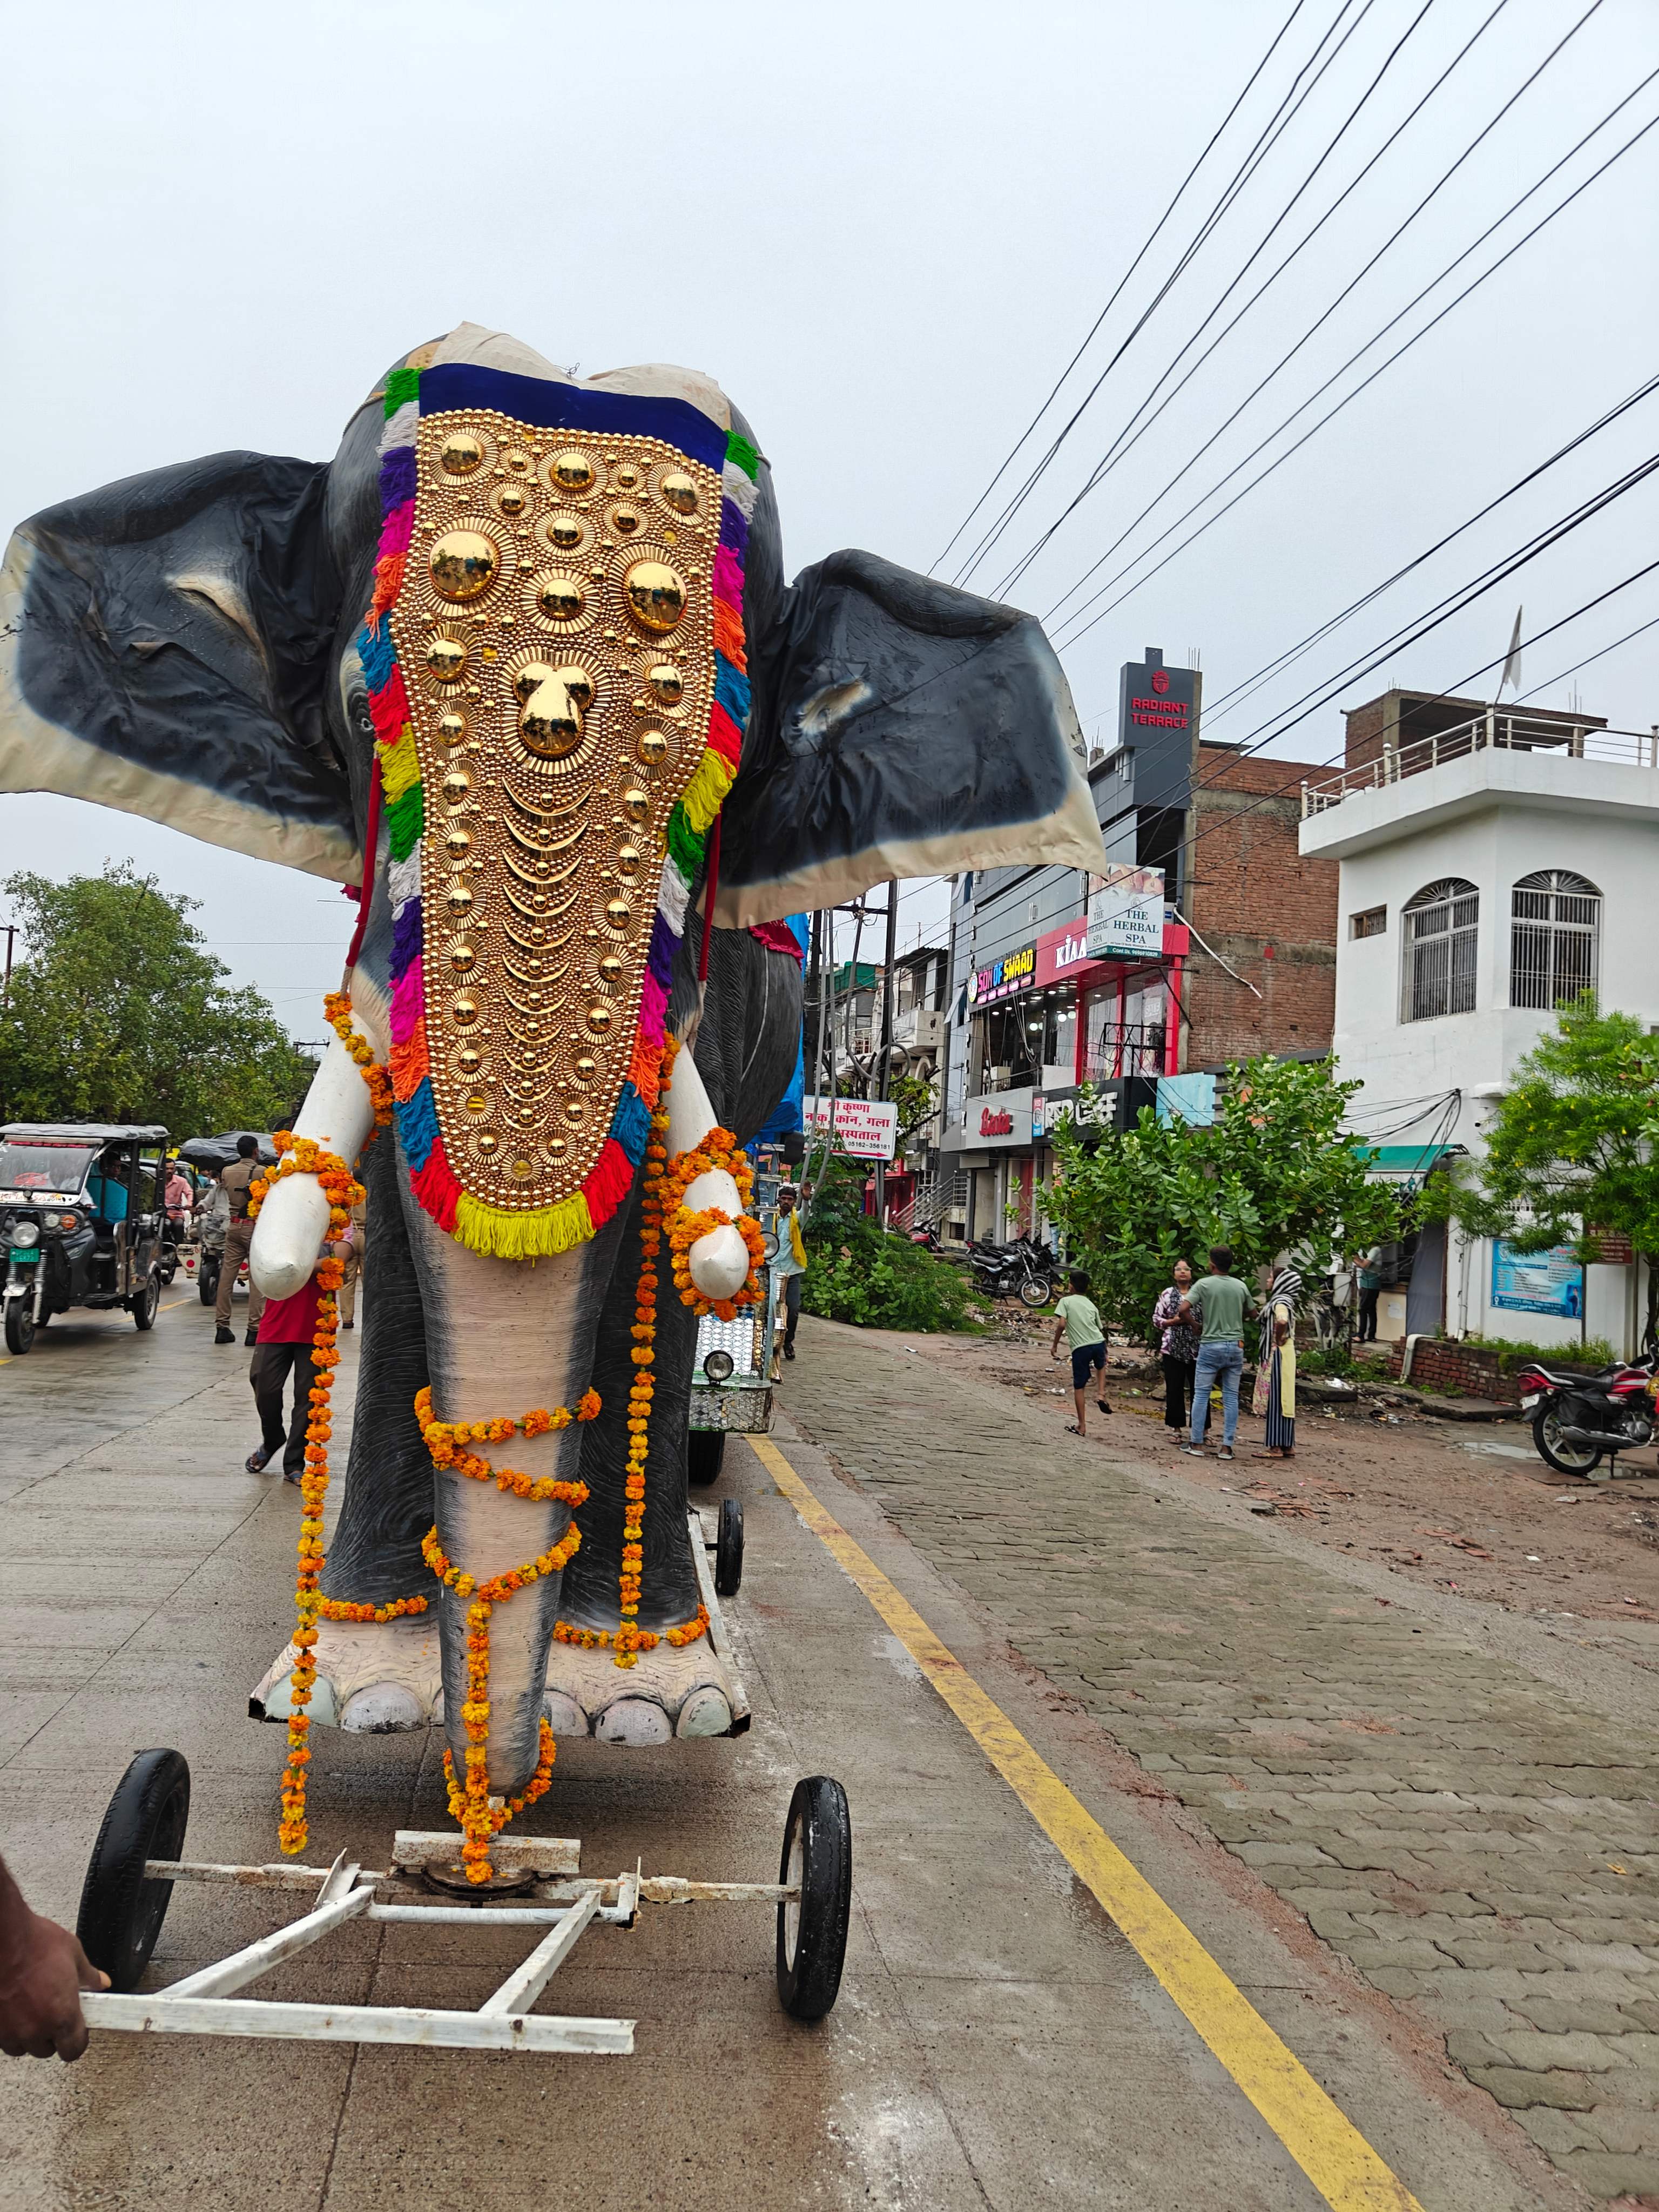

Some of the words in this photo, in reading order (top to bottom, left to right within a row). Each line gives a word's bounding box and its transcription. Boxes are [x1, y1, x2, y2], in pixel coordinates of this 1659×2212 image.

[1132, 698, 1188, 714] RADIANT
[1132, 713, 1188, 728] TERRACE
[1094, 910, 1104, 921] THE
[1127, 909, 1148, 920] THE
[1114, 920, 1159, 933] HERBAL
[1093, 934, 1102, 944] SPA
[1125, 934, 1146, 944] SPA
[978, 969, 993, 993] SON
[993, 962, 1003, 987] OF
[1003, 948, 1034, 982] SWAAD
[842, 1103, 871, 1114] कृष्णा
[835, 1115, 862, 1127] कान,
[866, 1117, 891, 1128] गला
[848, 1141, 891, 1149] 05162-356181
